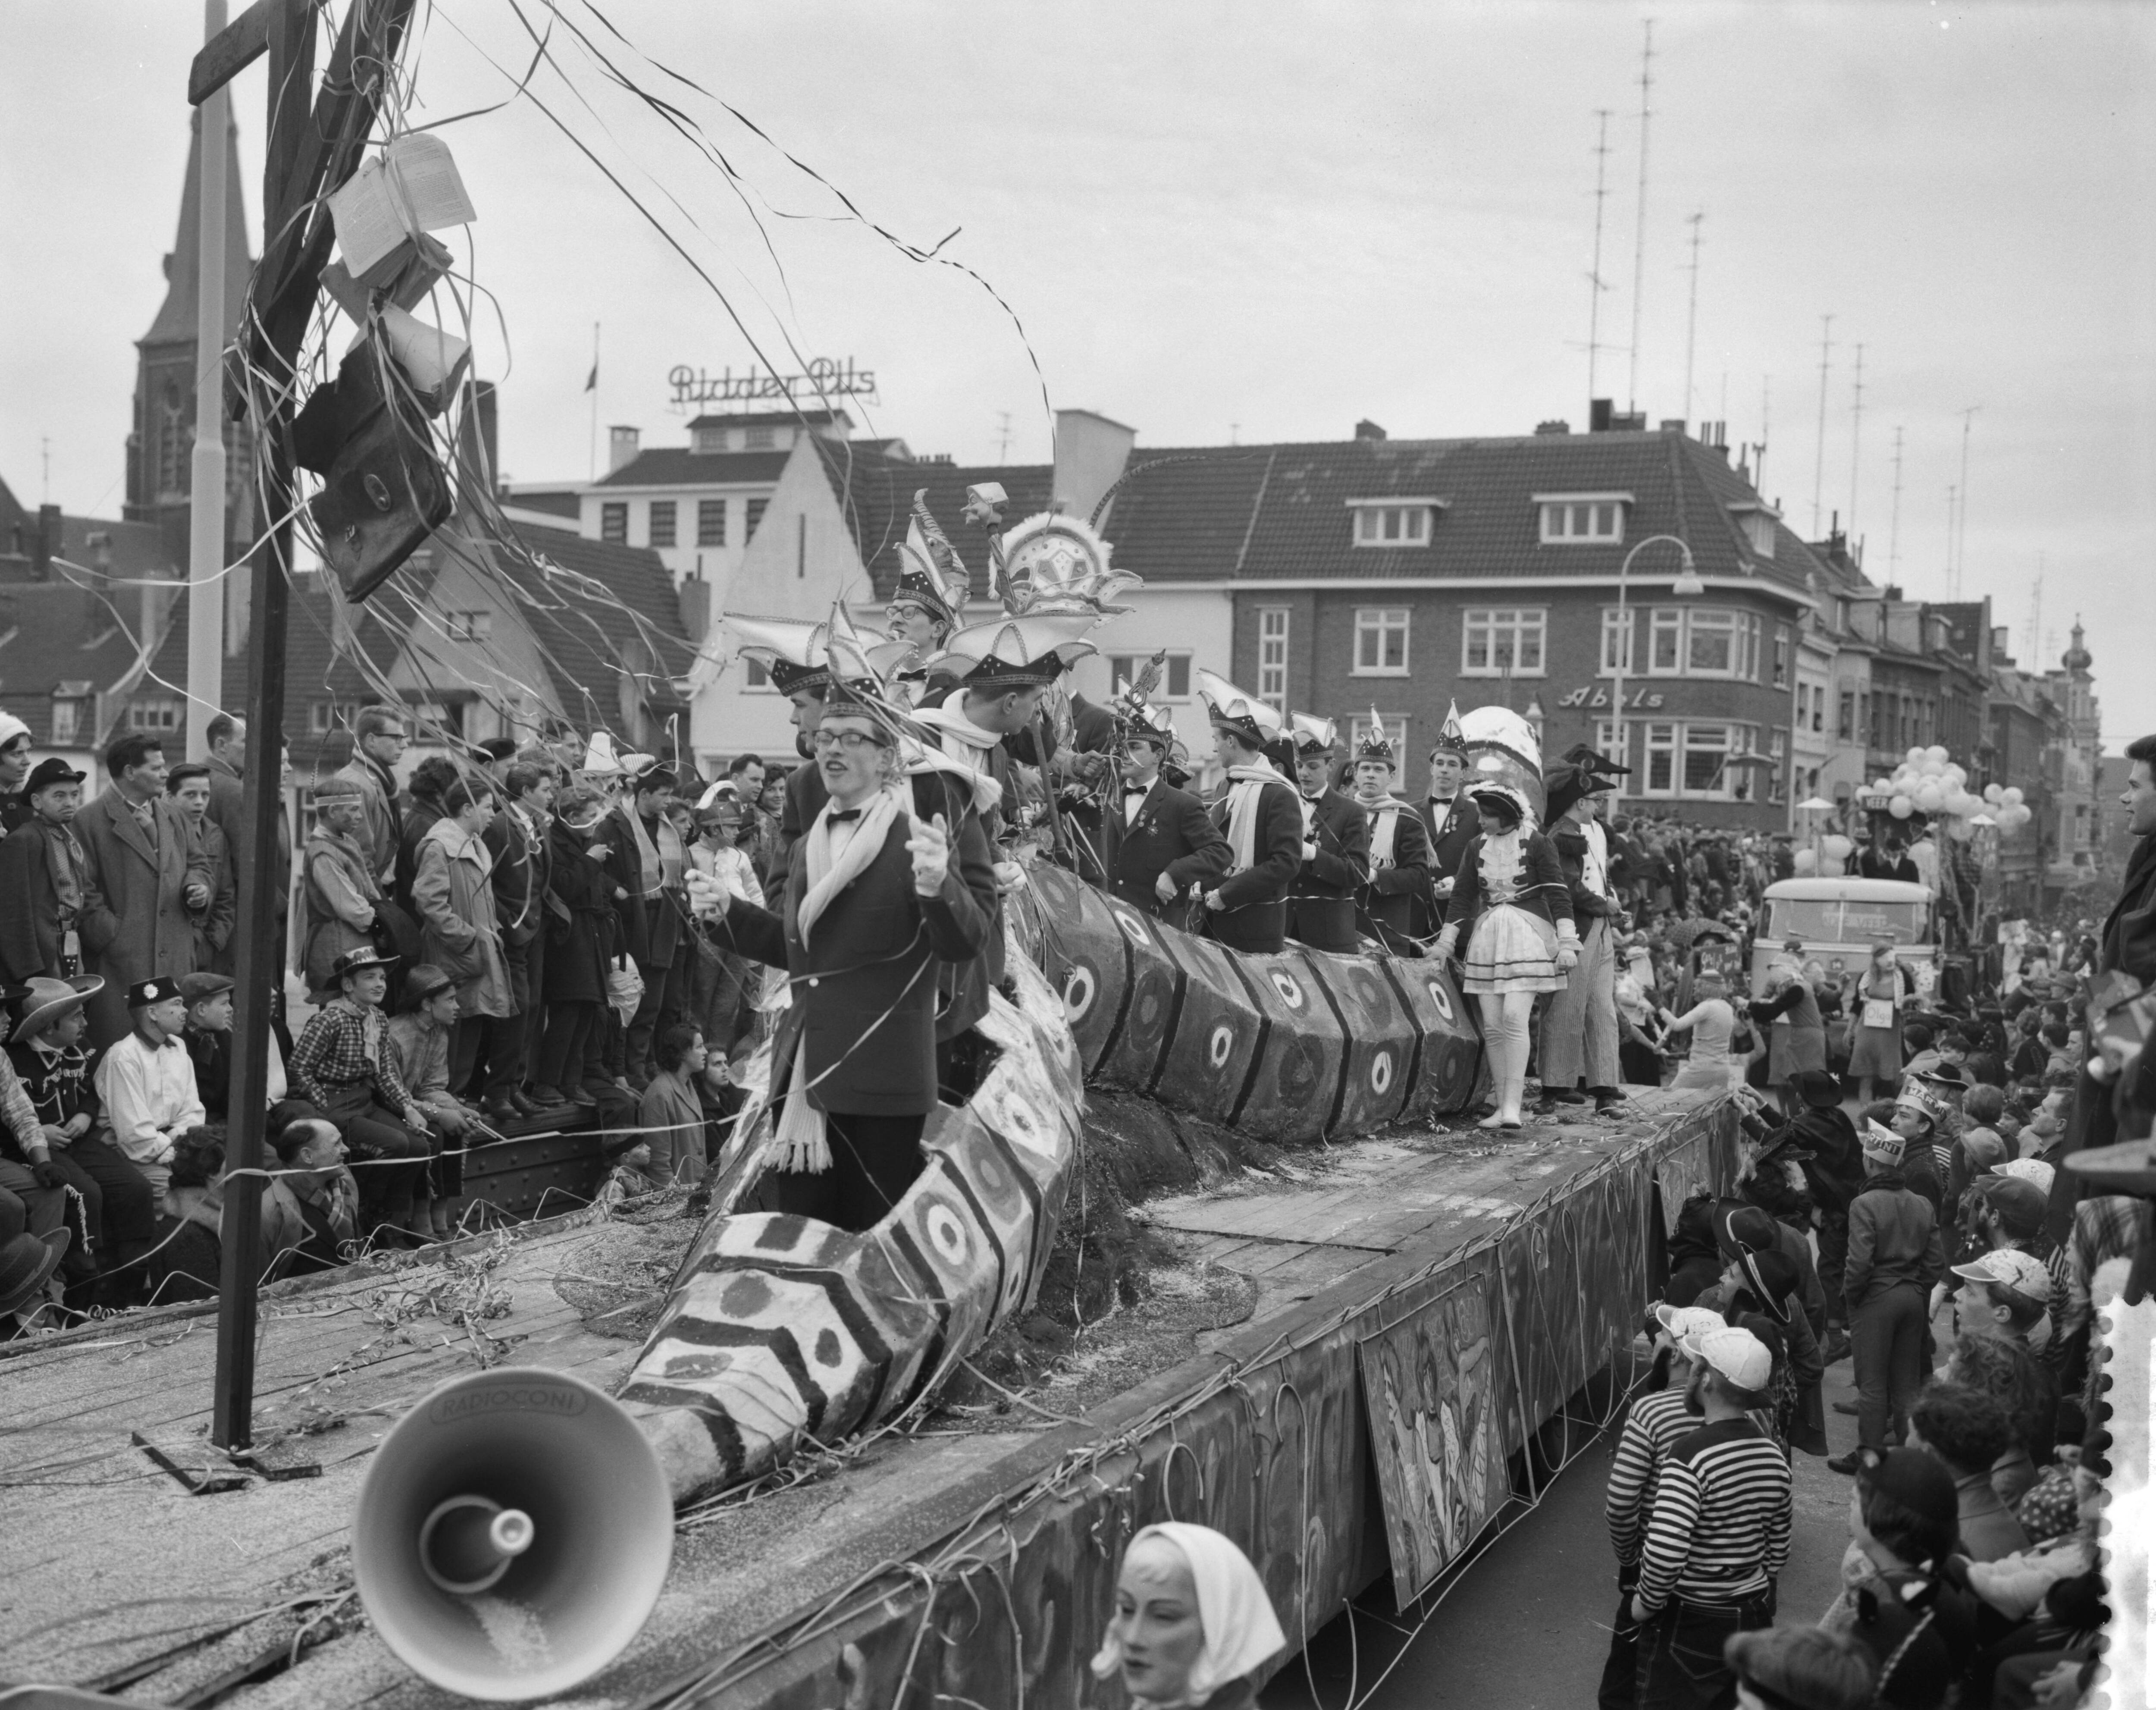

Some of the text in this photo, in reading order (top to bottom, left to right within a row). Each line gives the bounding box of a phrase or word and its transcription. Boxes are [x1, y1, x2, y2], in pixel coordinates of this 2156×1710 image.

[669, 355, 874, 402] Ridder Pils
[1867, 1007, 1891, 1024] Olga
